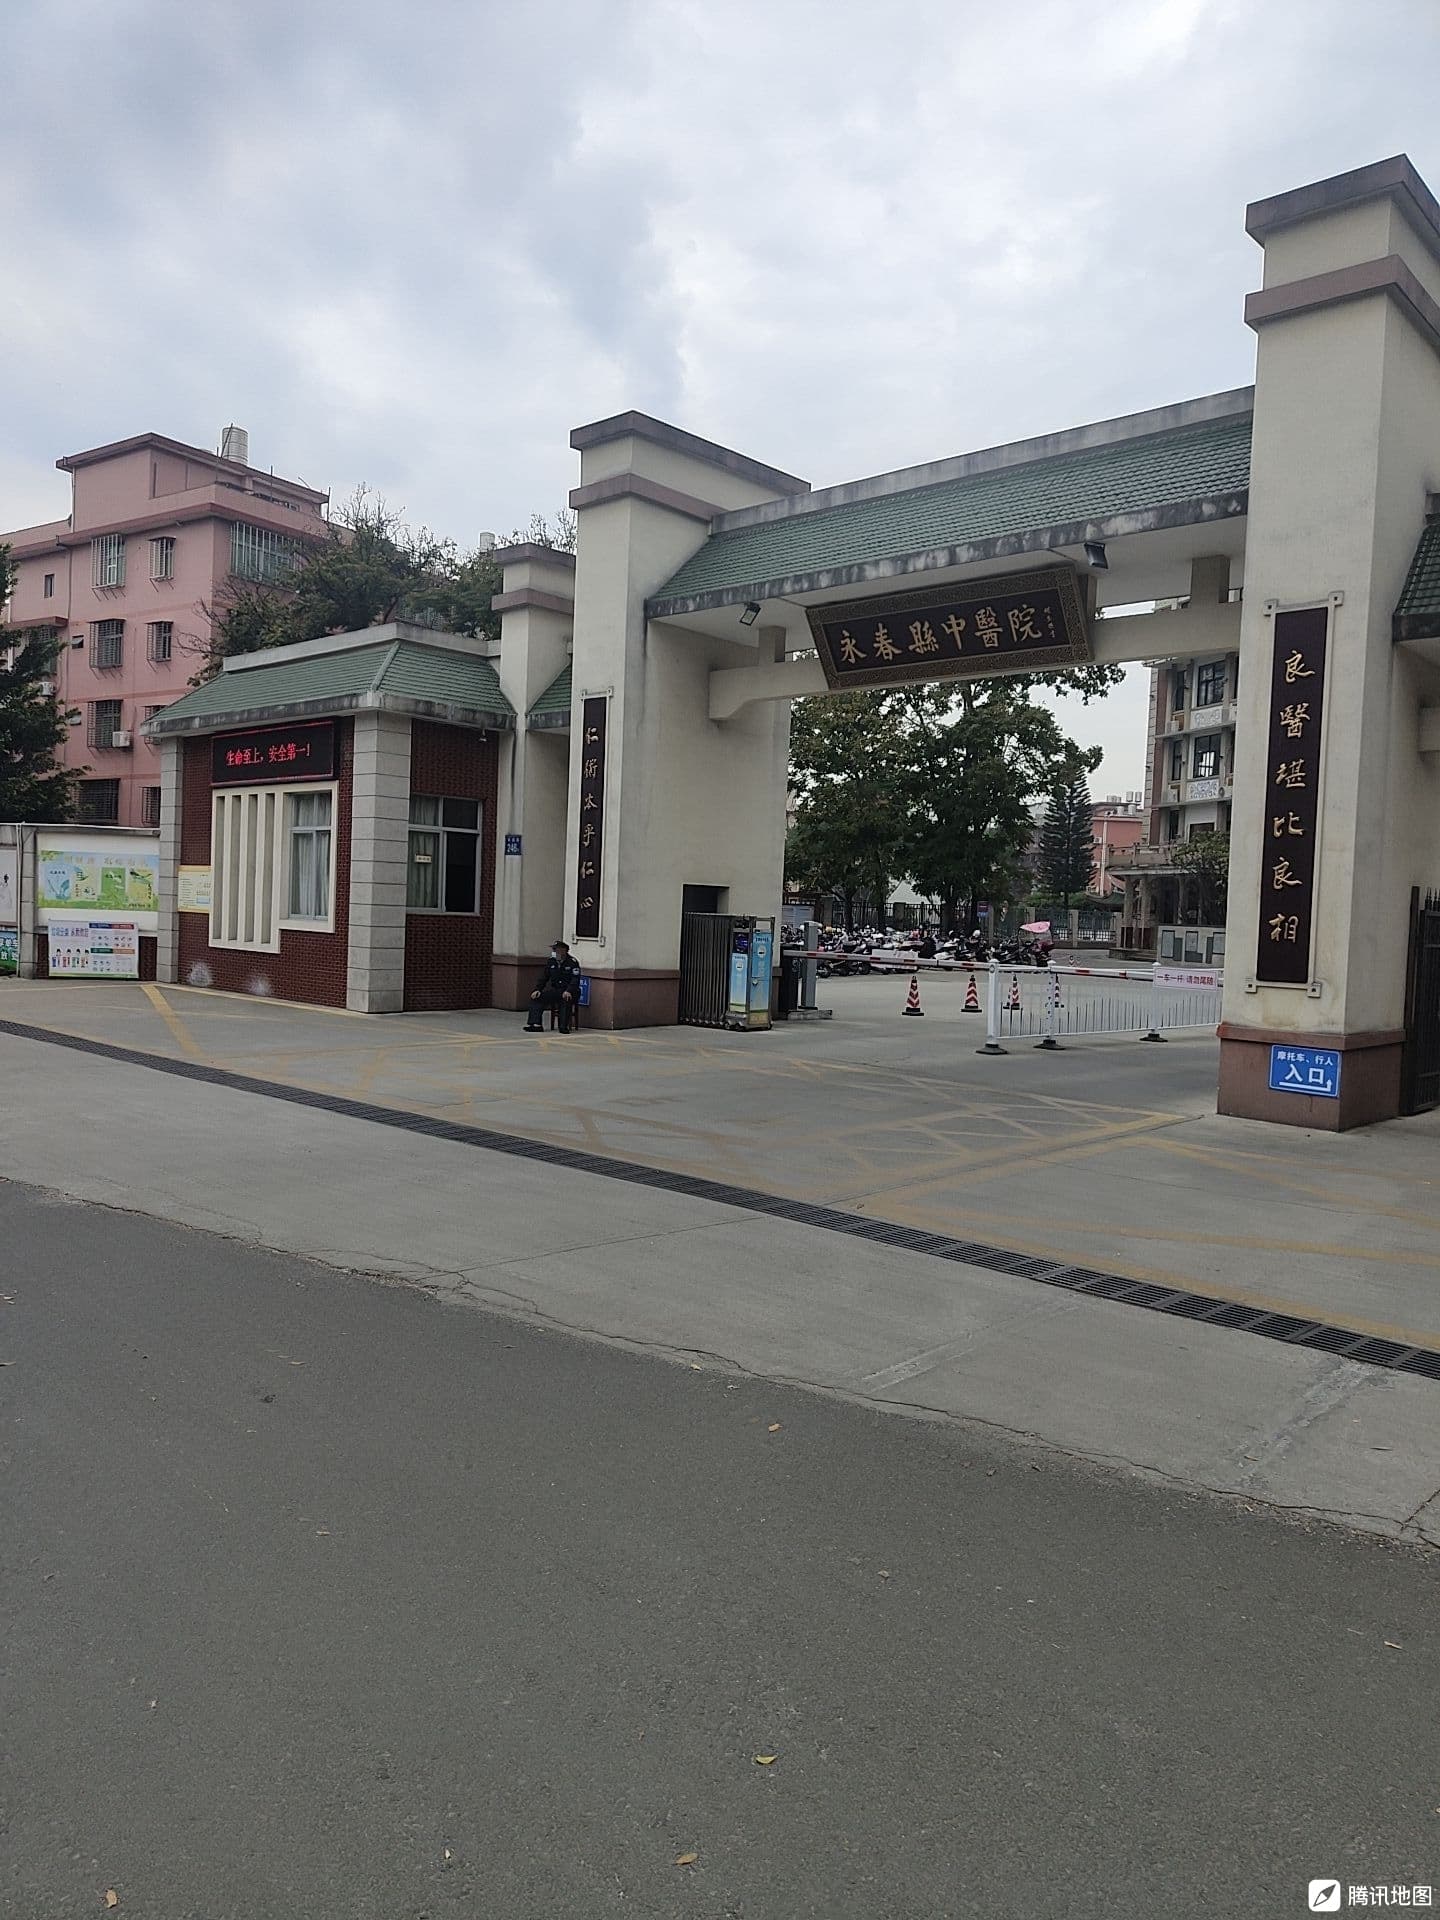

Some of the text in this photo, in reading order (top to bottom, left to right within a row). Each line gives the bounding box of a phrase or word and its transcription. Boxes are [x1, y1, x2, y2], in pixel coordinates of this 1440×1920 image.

[840, 604, 1042, 664] 永春縣中醫院
[1269, 650, 1315, 943] 良醫堪比良相
[1277, 1051, 1333, 1066] 摩托车、行人
[1284, 1063, 1325, 1085] 入口
